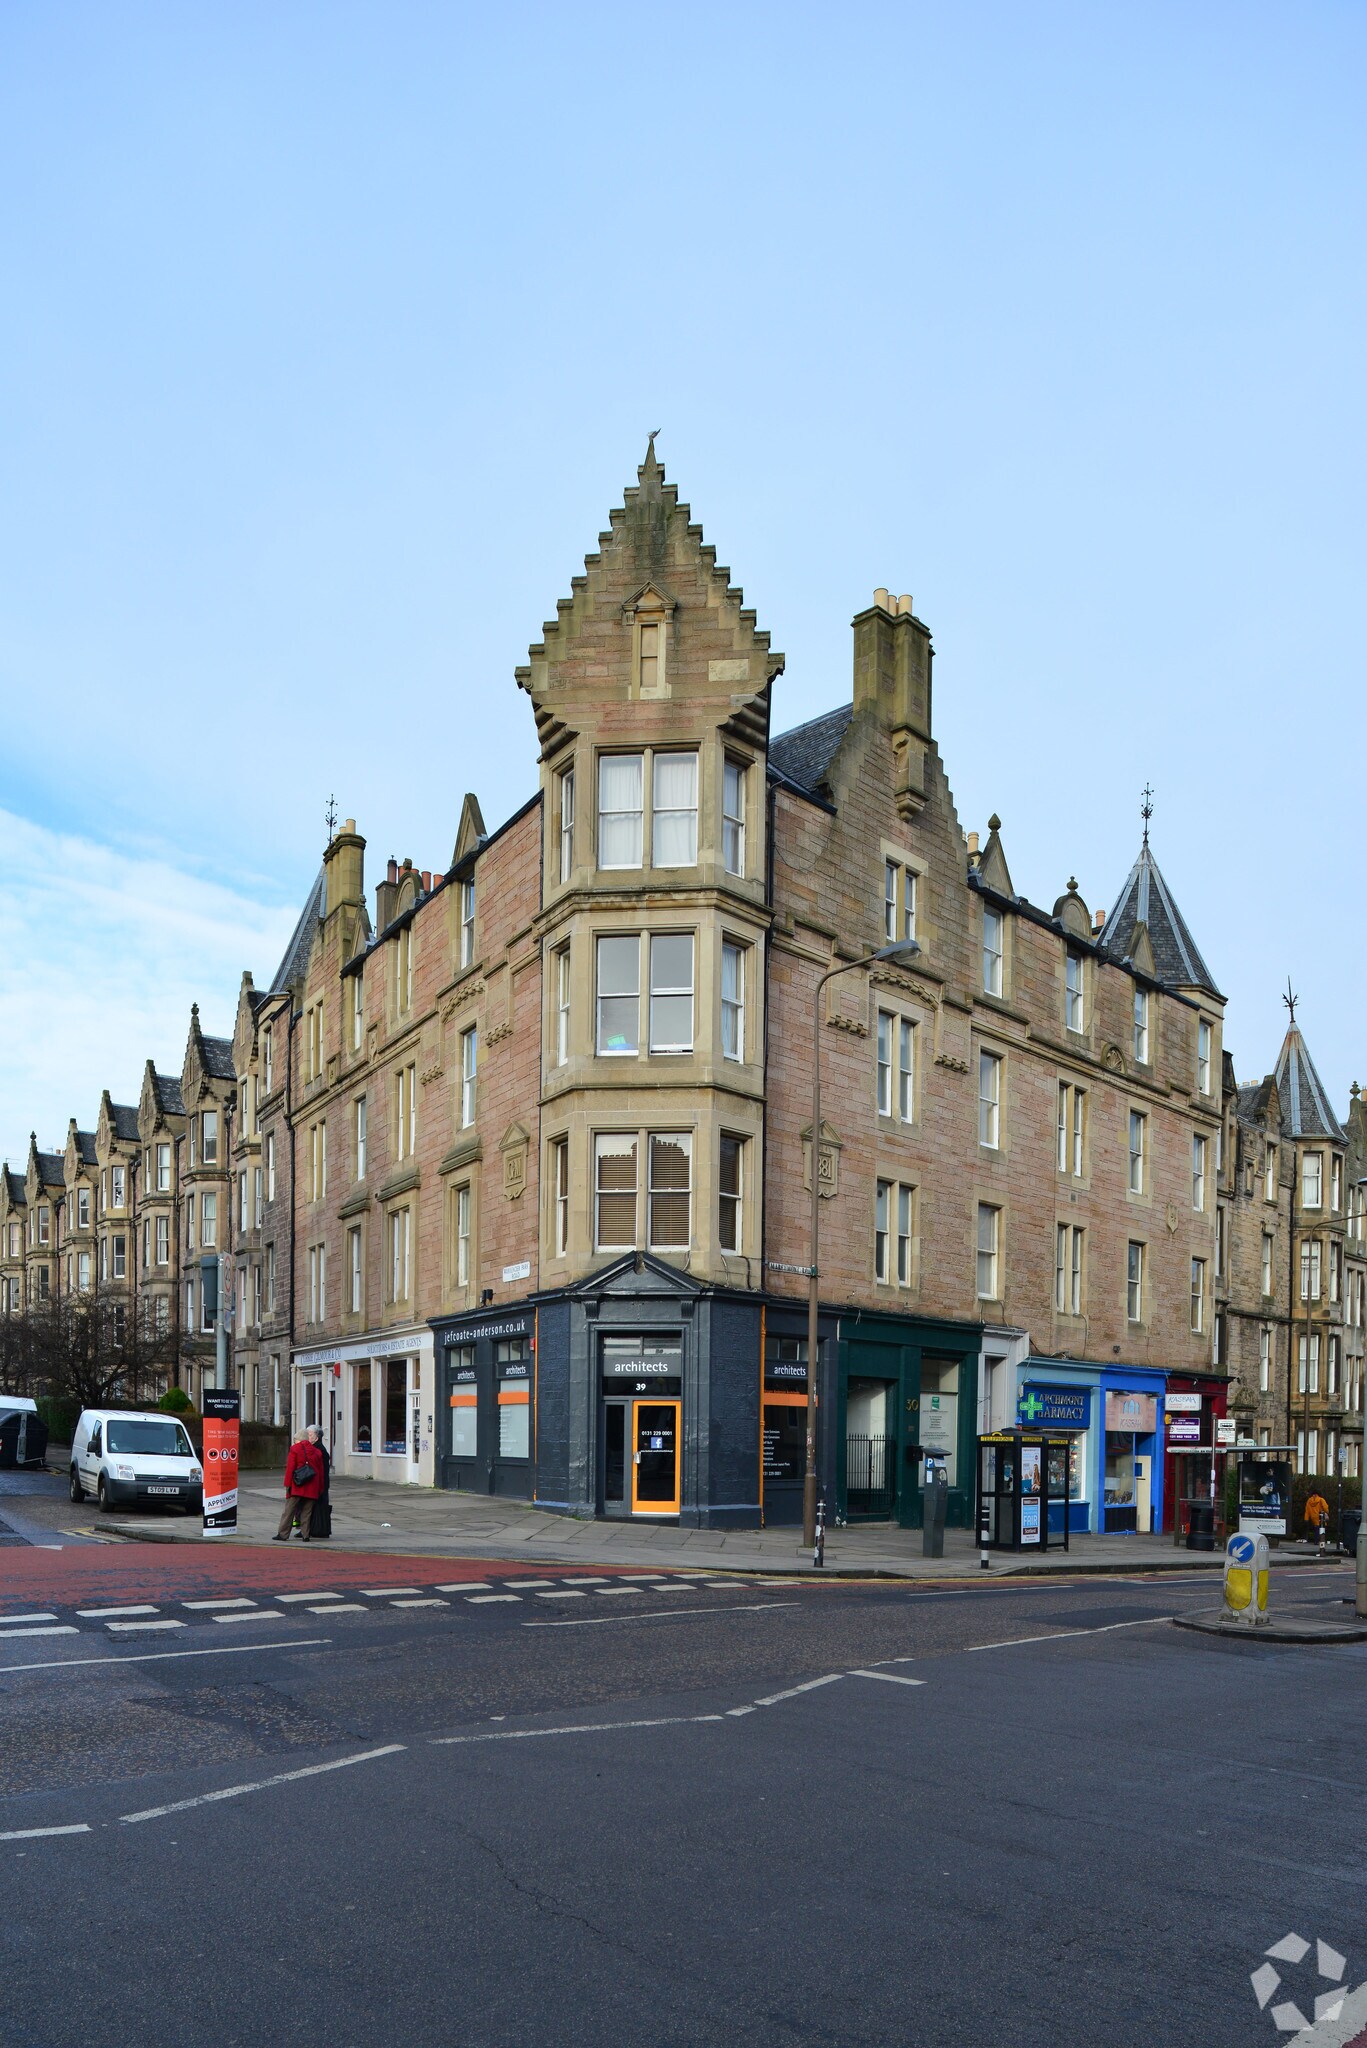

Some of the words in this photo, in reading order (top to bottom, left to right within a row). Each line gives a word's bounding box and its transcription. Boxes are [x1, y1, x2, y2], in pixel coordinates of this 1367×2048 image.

[444, 1318, 526, 1345] jefcoate-anderson.co.uk
[406, 1337, 422, 1348] AGENTS
[506, 1365, 526, 1375] architects
[615, 1361, 669, 1372] architects
[774, 1365, 807, 1376] architects
[457, 1371, 476, 1380] architects
[635, 1383, 647, 1391] 39
[906, 1399, 919, 1411] 30
[927, 1458, 933, 1468] P
[208, 1498, 226, 1507] APPLY
[1023, 1515, 1038, 1527] FAIR
